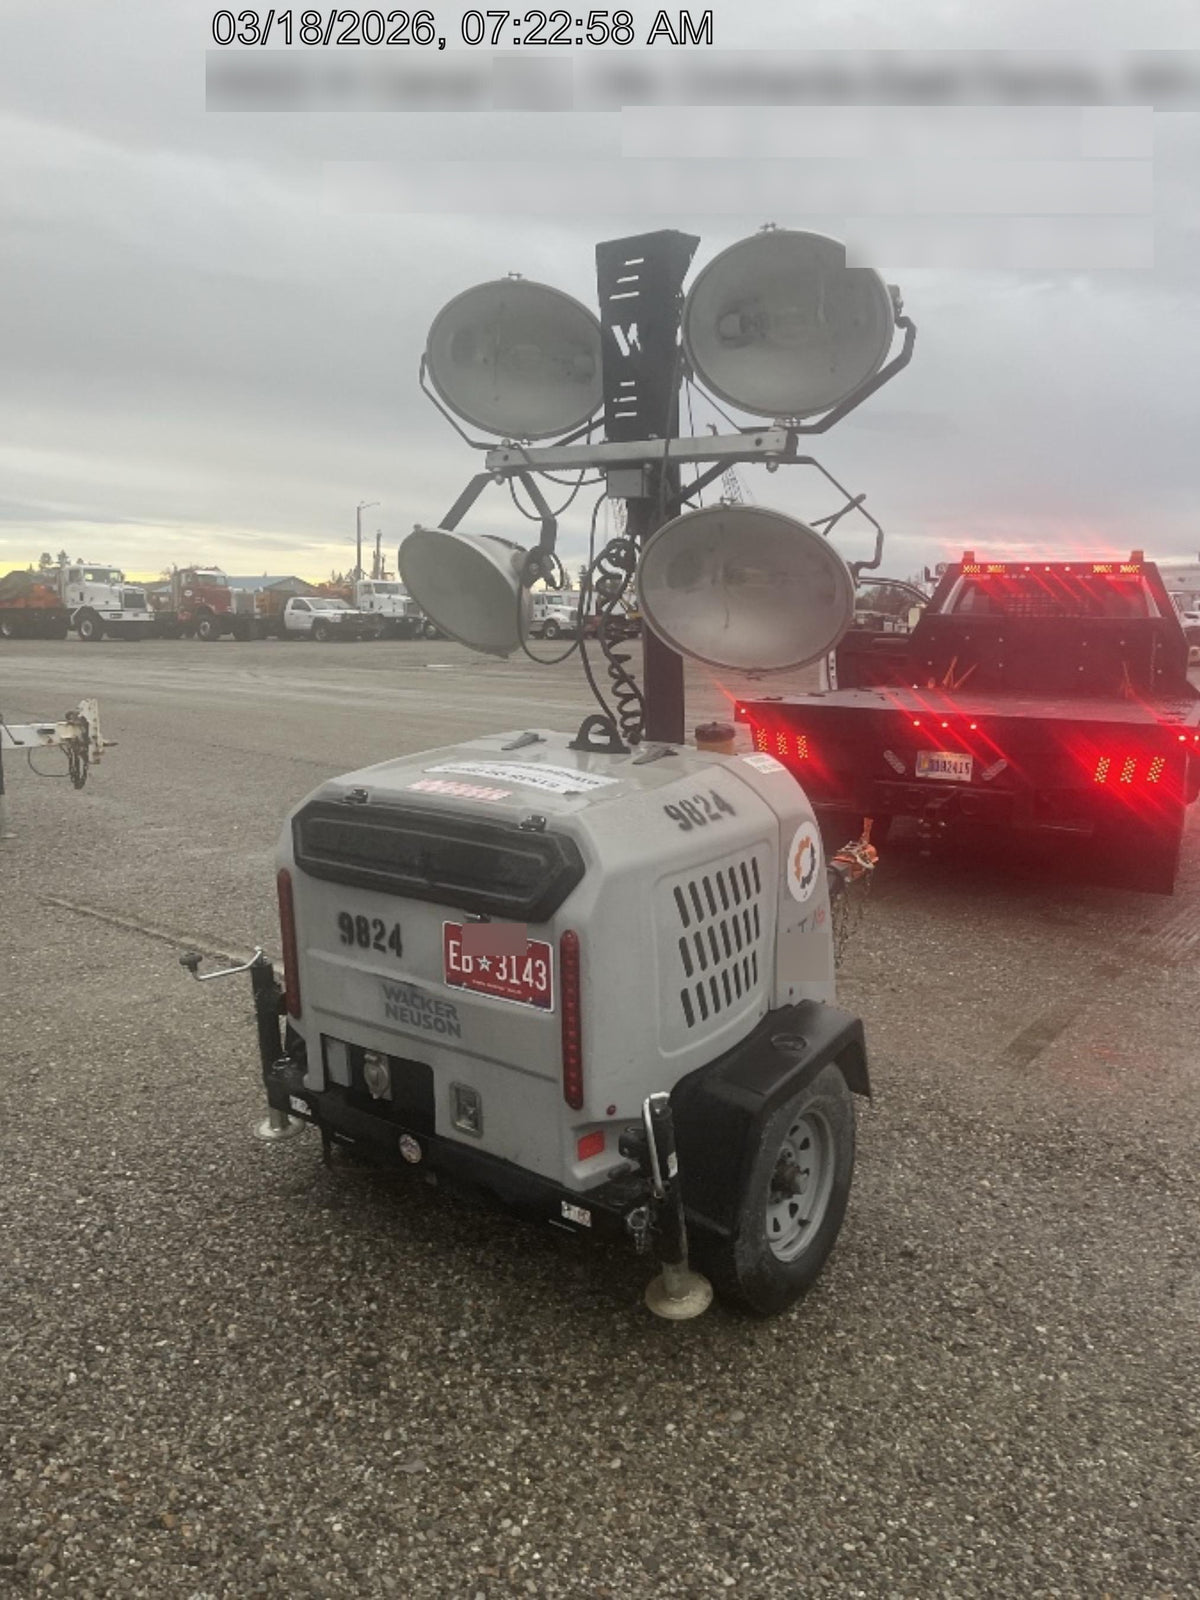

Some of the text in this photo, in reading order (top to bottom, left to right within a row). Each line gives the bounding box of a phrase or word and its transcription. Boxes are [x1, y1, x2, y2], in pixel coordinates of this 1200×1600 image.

[663, 789, 737, 831] 9824
[338, 911, 403, 958] 9824
[382, 983, 460, 1021] WACKER
[384, 1002, 462, 1039] NEUSON
